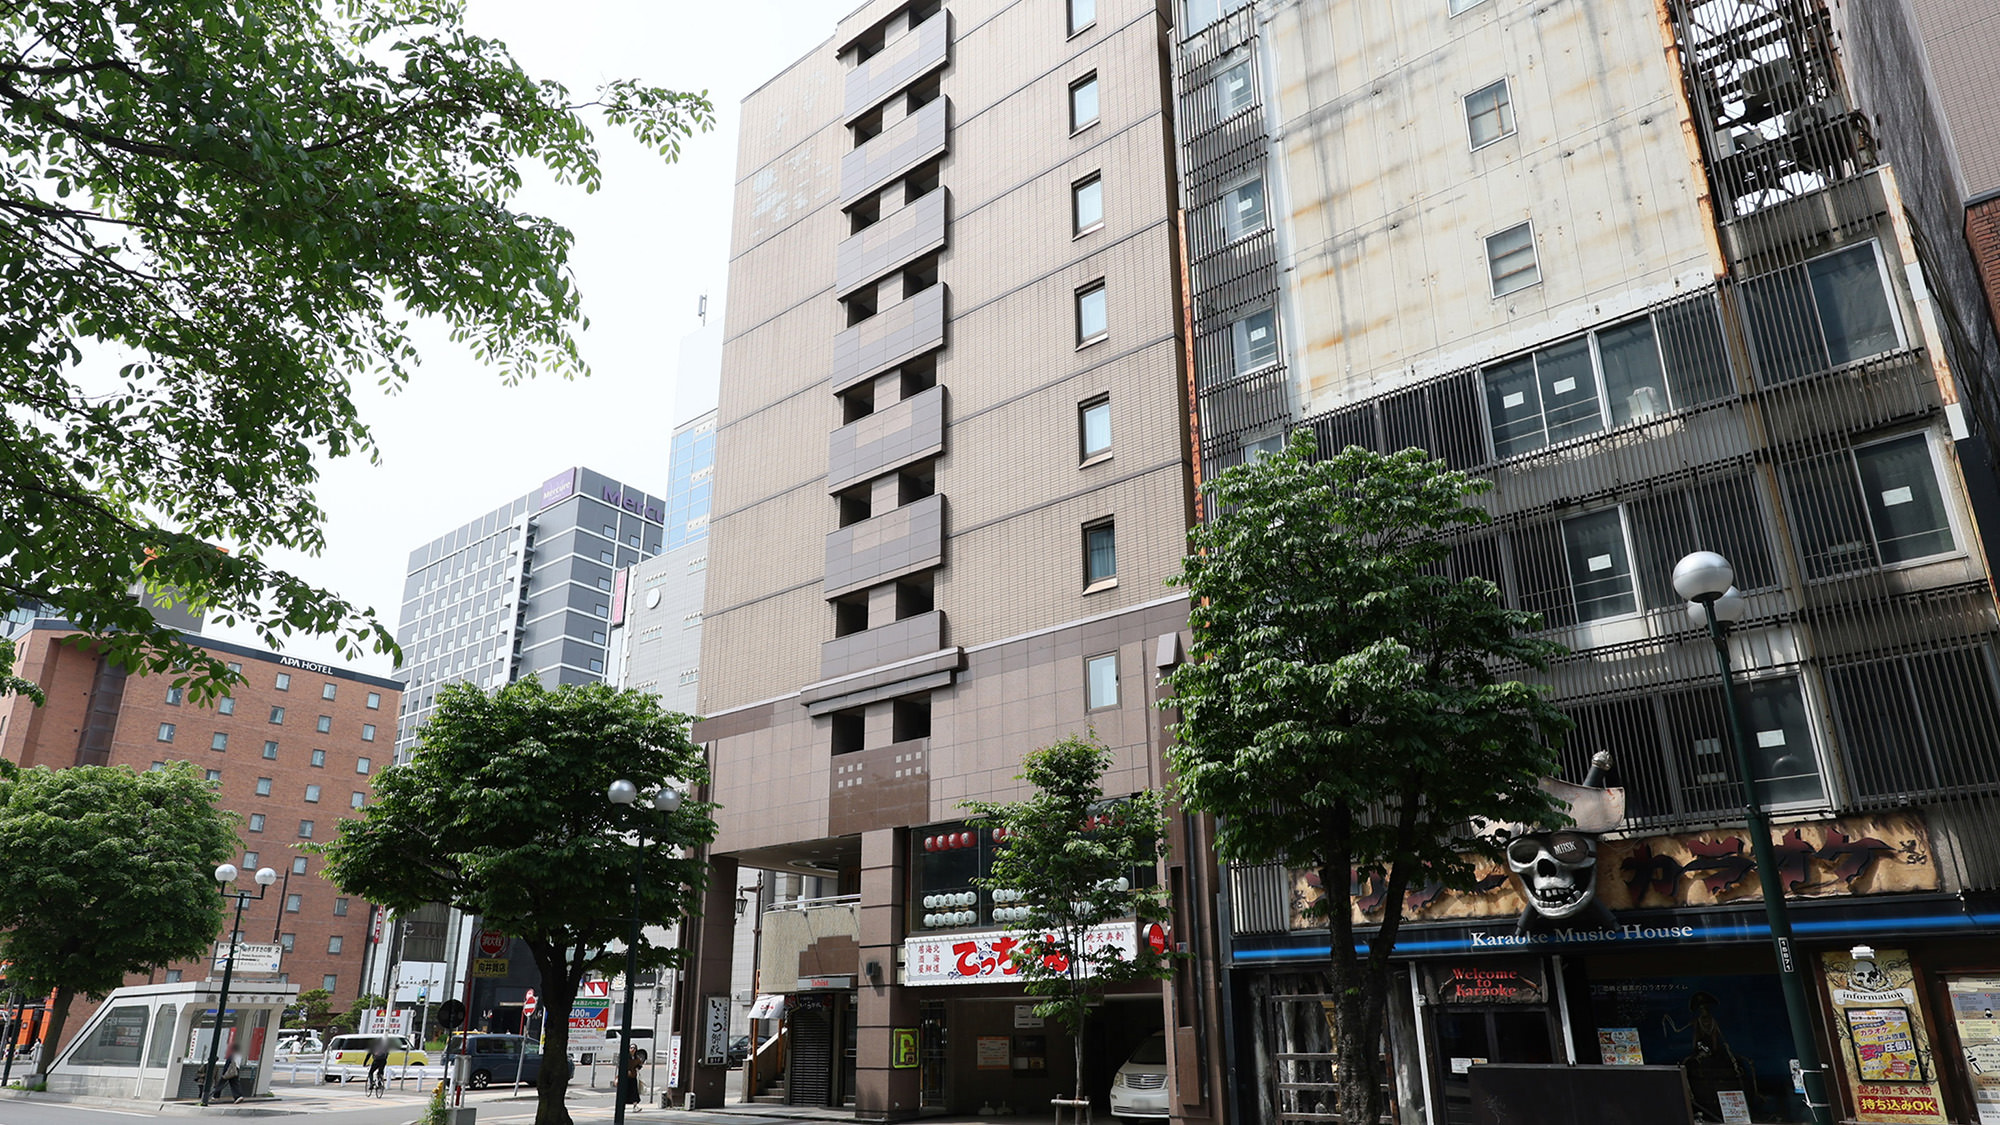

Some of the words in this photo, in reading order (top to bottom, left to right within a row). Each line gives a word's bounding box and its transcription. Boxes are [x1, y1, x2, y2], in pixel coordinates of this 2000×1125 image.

[544, 481, 571, 500] Mercure
[280, 656, 300, 668] APA
[301, 661, 333, 675] HOTEL
[1471, 930, 1549, 947] Karaoke
[1555, 925, 1617, 943] Music
[1621, 923, 1694, 940] House
[1452, 967, 1518, 980] Welcome
[1477, 978, 1491, 988] to
[1455, 984, 1518, 997] Karaoke
[1842, 991, 1904, 1000] information
[1857, 1085, 1933, 1096] 飲み物・食べ物
[1861, 1098, 1937, 1112] 持ち込みOK
